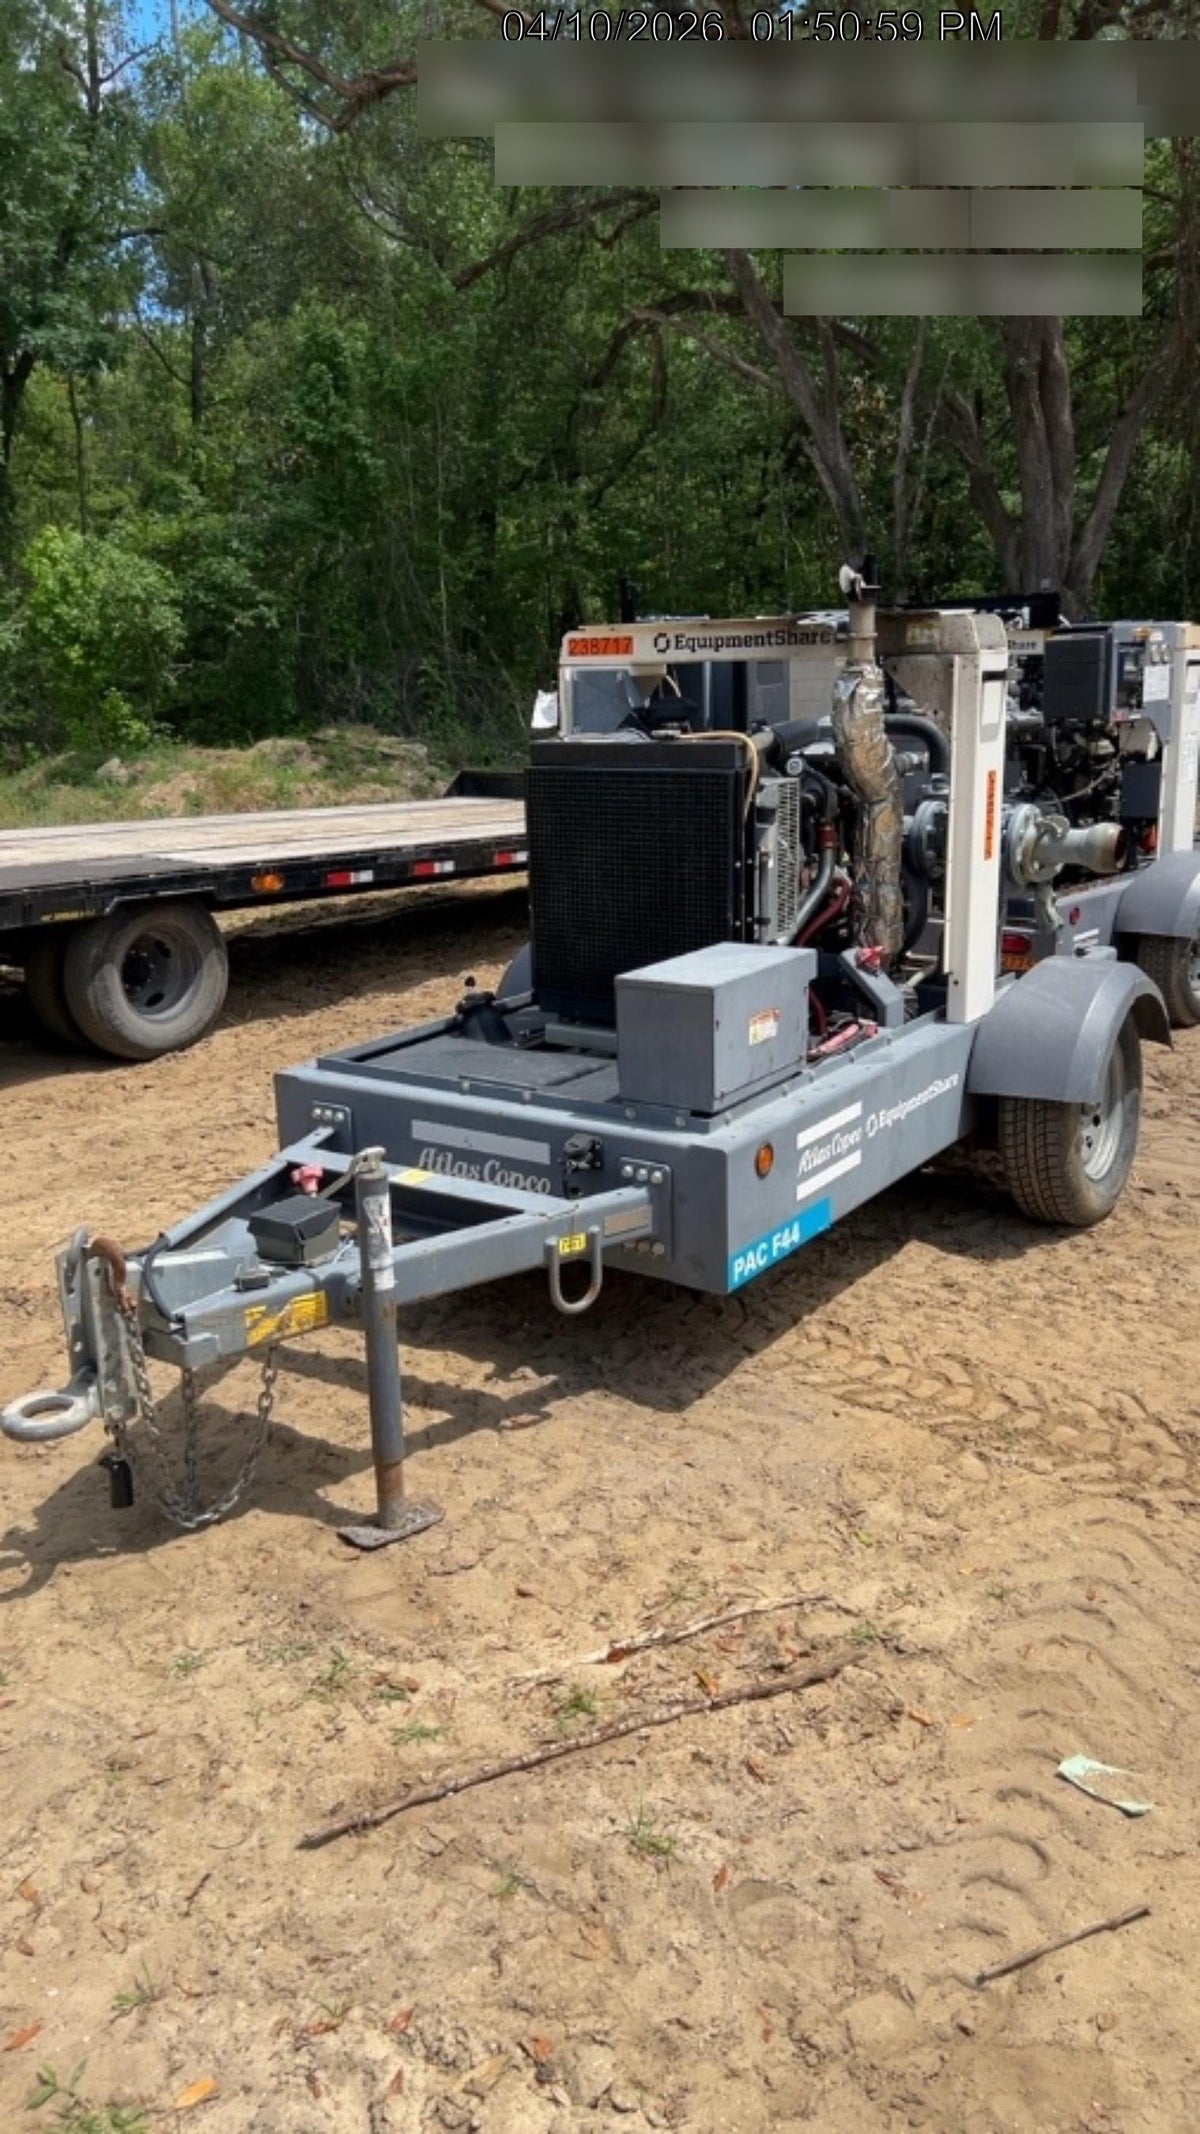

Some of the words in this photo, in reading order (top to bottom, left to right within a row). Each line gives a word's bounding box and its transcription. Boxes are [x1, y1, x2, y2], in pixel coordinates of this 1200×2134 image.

[568, 636, 633, 656] 238717
[675, 630, 831, 652] EquipmentShare
[879, 1073, 960, 1130] EquipmentShare
[418, 1147, 481, 1180] Atlas
[797, 1144, 832, 1177] Atlas
[733, 1241, 769, 1283] PAC
[771, 1220, 801, 1258] F44
